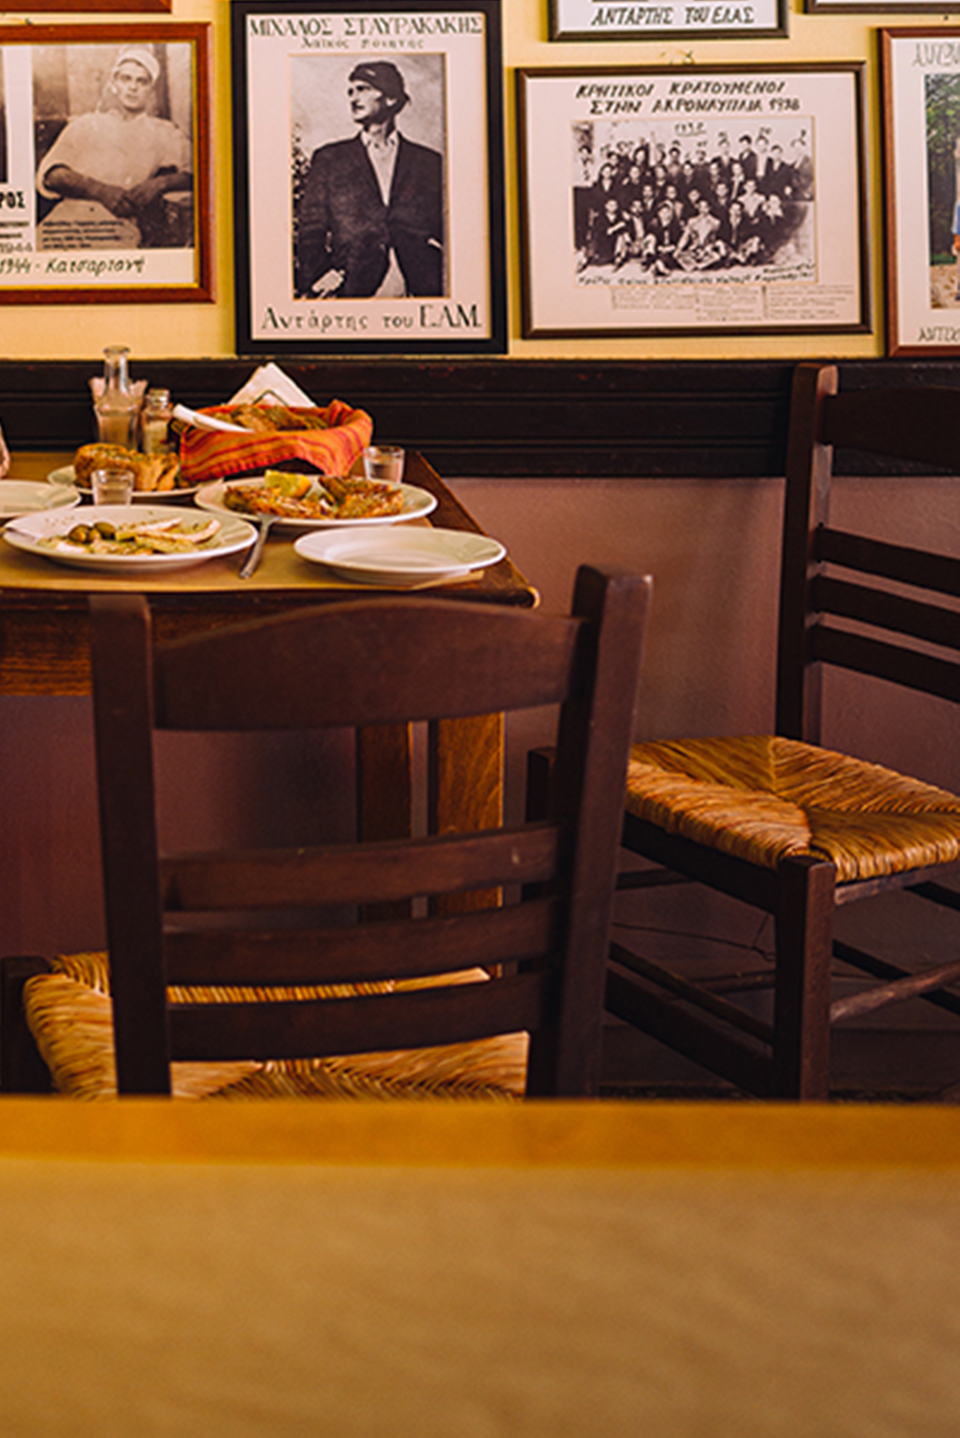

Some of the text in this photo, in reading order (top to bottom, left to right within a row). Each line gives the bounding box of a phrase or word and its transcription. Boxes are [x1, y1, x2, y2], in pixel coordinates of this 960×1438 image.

[591, 6, 675, 26] ΑΝΤΑΡΤΗΣ
[575, 80, 787, 99] ΚΡΗΤΙΚΟΙ ΚΡΑΤΟΥΜΕΝΟΙ
[590, 99, 642, 116] ΣΤΗΝ
[261, 306, 369, 334] Αντάρτης
[381, 311, 415, 330] του
